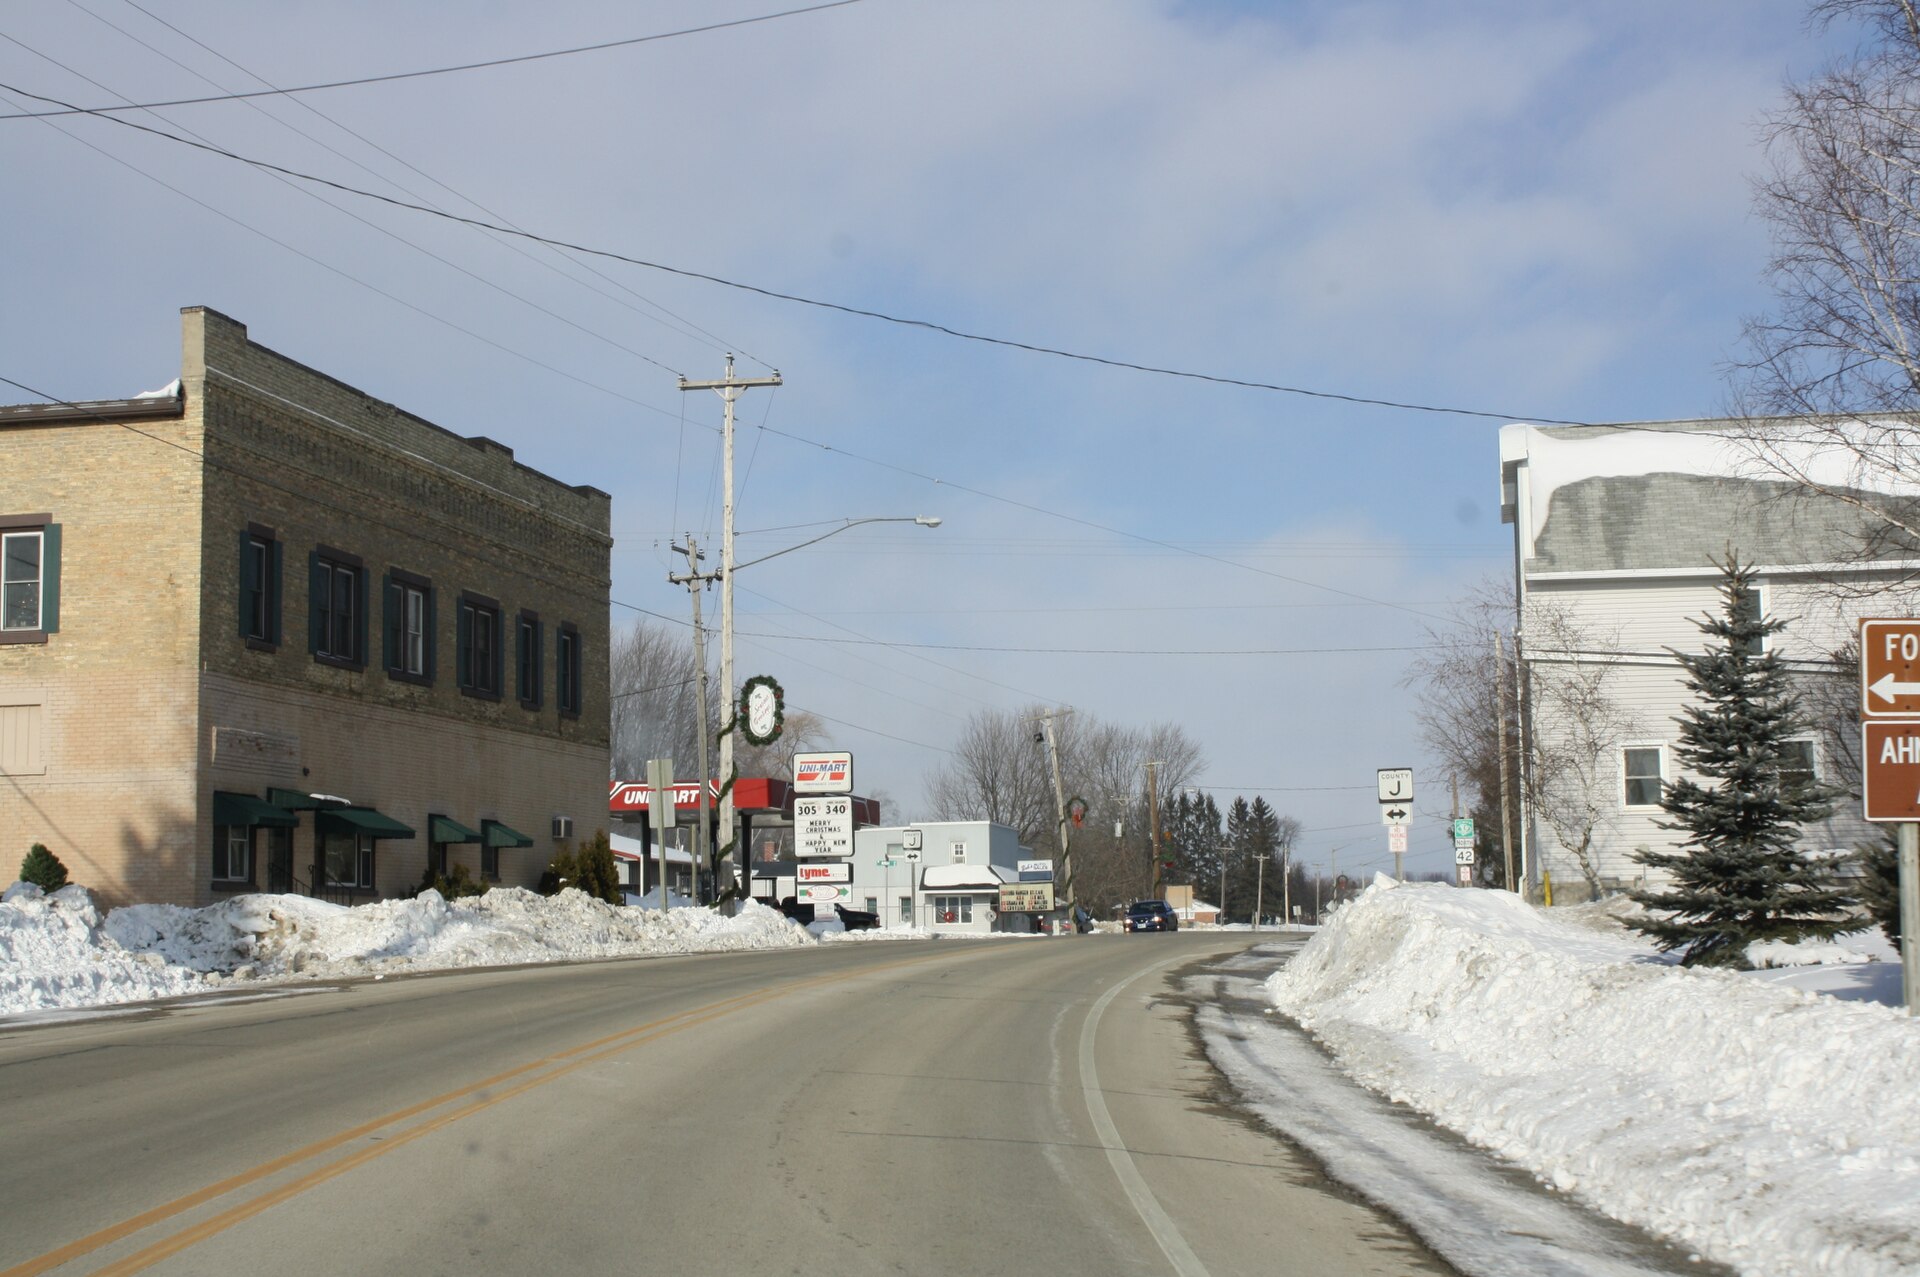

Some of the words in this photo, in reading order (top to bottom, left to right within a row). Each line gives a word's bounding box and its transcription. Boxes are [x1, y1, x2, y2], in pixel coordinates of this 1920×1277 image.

[1885, 633, 1920, 661] FO
[1389, 780, 1401, 796] J
[798, 805, 817, 815] 305
[825, 804, 846, 815] 340
[805, 826, 841, 834] CHRISTMAS
[908, 836, 916, 846] J
[1456, 851, 1473, 861] 42
